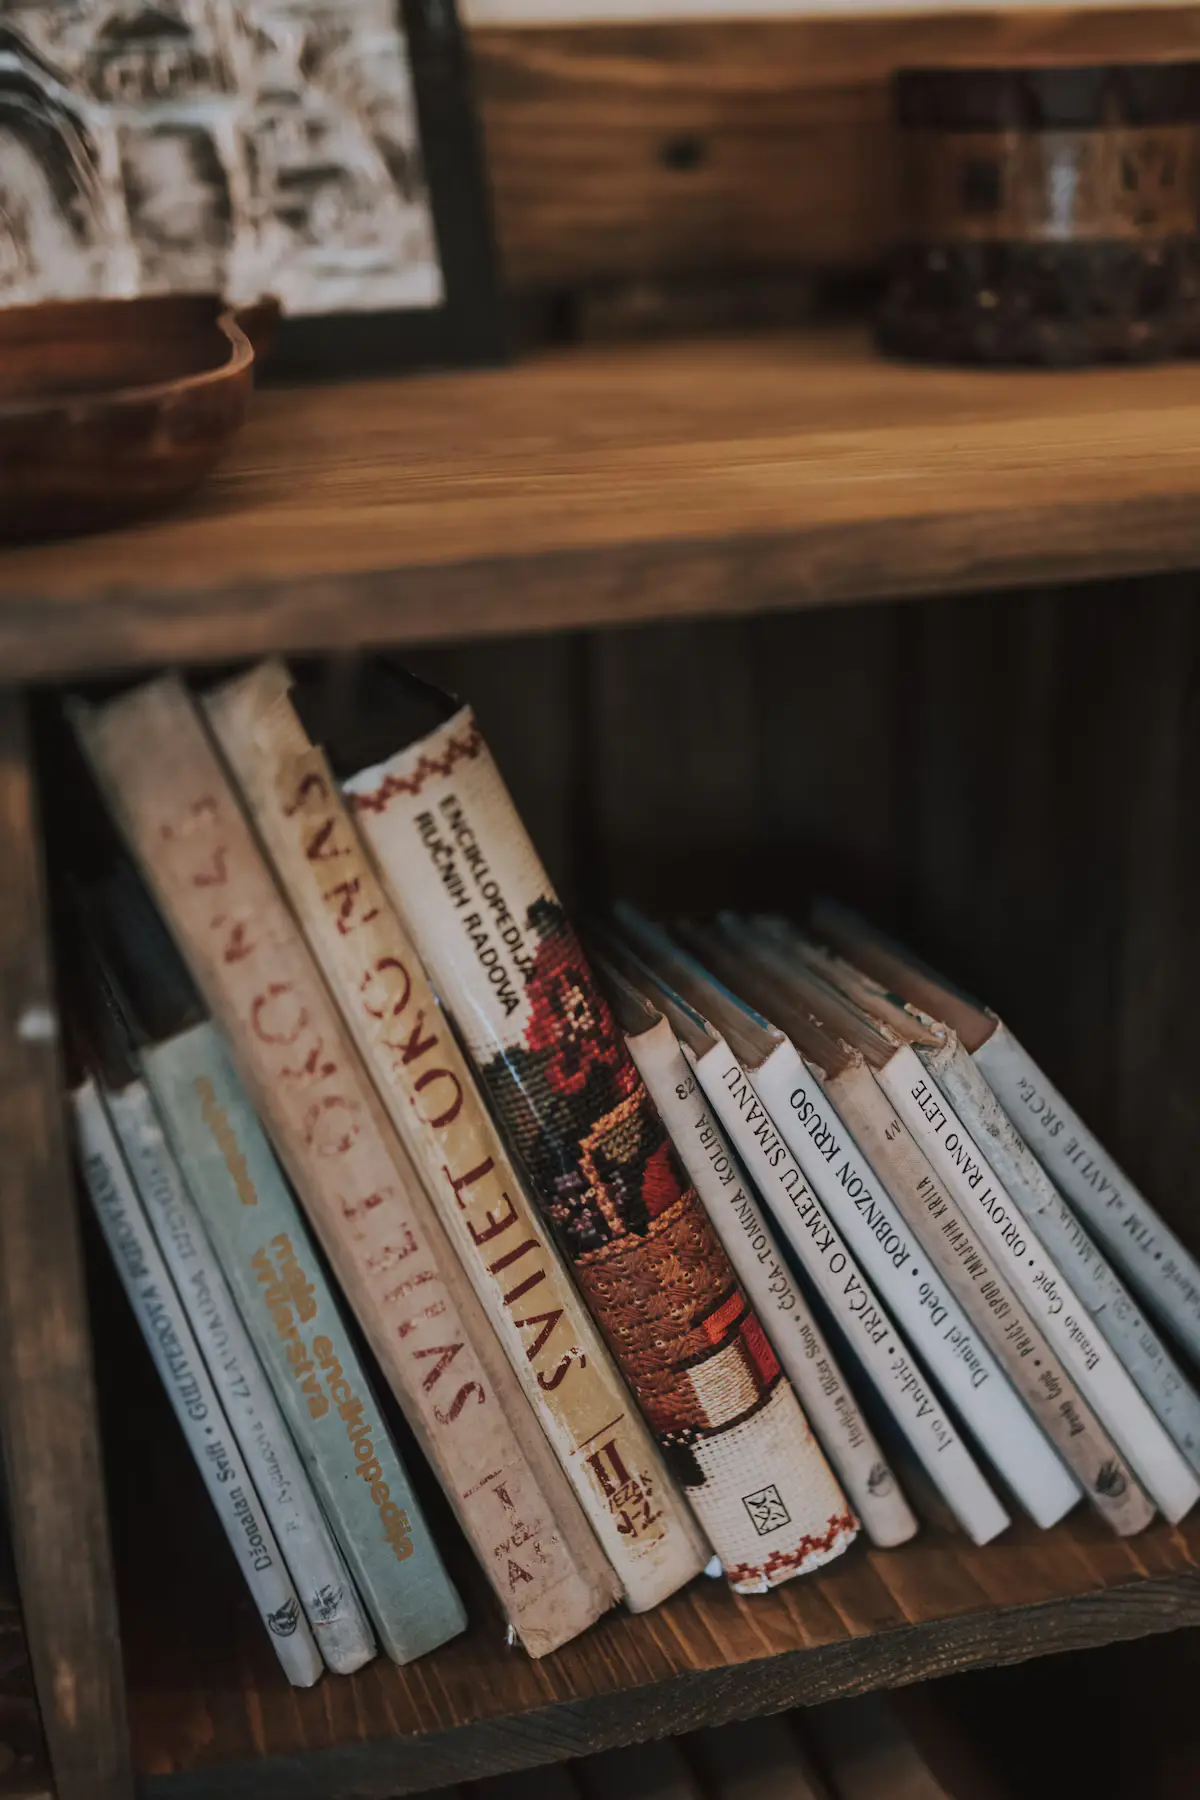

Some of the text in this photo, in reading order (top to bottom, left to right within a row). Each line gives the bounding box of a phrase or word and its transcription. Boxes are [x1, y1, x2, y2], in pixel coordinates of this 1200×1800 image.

[413, 810, 520, 1018] RUČNIH RADOVA
[439, 794, 538, 984] ENCIKLOPEDIJA
[248, 978, 361, 1156] OKO
[282, 773, 587, 1391] SVIJET OKO NAS
[694, 1109, 736, 1187] KOLIBA
[916, 1176, 948, 1219] KRILA
[721, 1066, 953, 1453] Ivo Andrić PRIČA O KMETU SIMANU
[729, 1188, 796, 1311] ČIČA-TOMINA
[789, 1088, 989, 1390] Danijel Defo ROBINZON KRUSO
[910, 1079, 1101, 1371] Branko Čopić ORLOVI RANO LETE
[941, 1218, 988, 1281] ZMAJEVIH
[1122, 1214, 1155, 1253] TIM
[141, 1285, 209, 1422] GULIVEROVA
[340, 1187, 486, 1426] SVIJET
[799, 1324, 818, 1359] Stou
[979, 1280, 1011, 1320] ISPOD
[1003, 1319, 1036, 1358] PRIČE
[313, 1335, 414, 1562] enciklopedija
[586, 1438, 632, 1498] II
[229, 1486, 274, 1572] Džonatan
